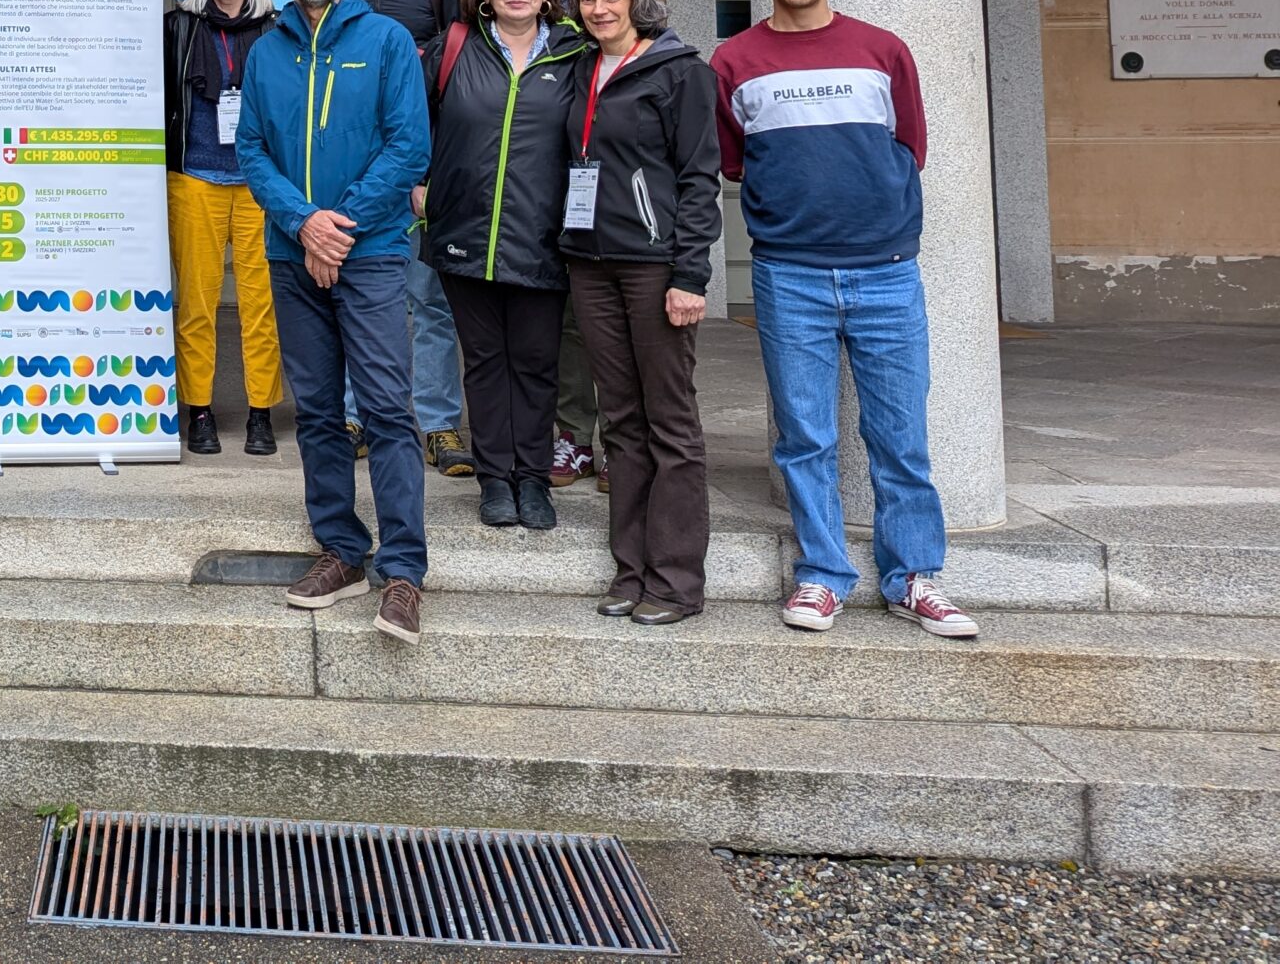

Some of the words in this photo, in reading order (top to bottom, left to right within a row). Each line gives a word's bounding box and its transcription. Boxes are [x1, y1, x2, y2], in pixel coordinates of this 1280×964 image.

[1164, 0, 1196, 8] VOLLE
[1199, 0, 1235, 7] DONARE
[773, 84, 853, 101] PULL&BEAR
[40, 130, 118, 143] 1.435.295,65
[23, 150, 49, 161] CHF
[51, 150, 119, 163] 280.000,05
[1, 212, 13, 230] 5
[83, 212, 125, 220] PROGETTO
[1, 240, 14, 258] 2
[35, 239, 72, 247] PARTNER
[73, 239, 115, 247] ASSOCIATI
